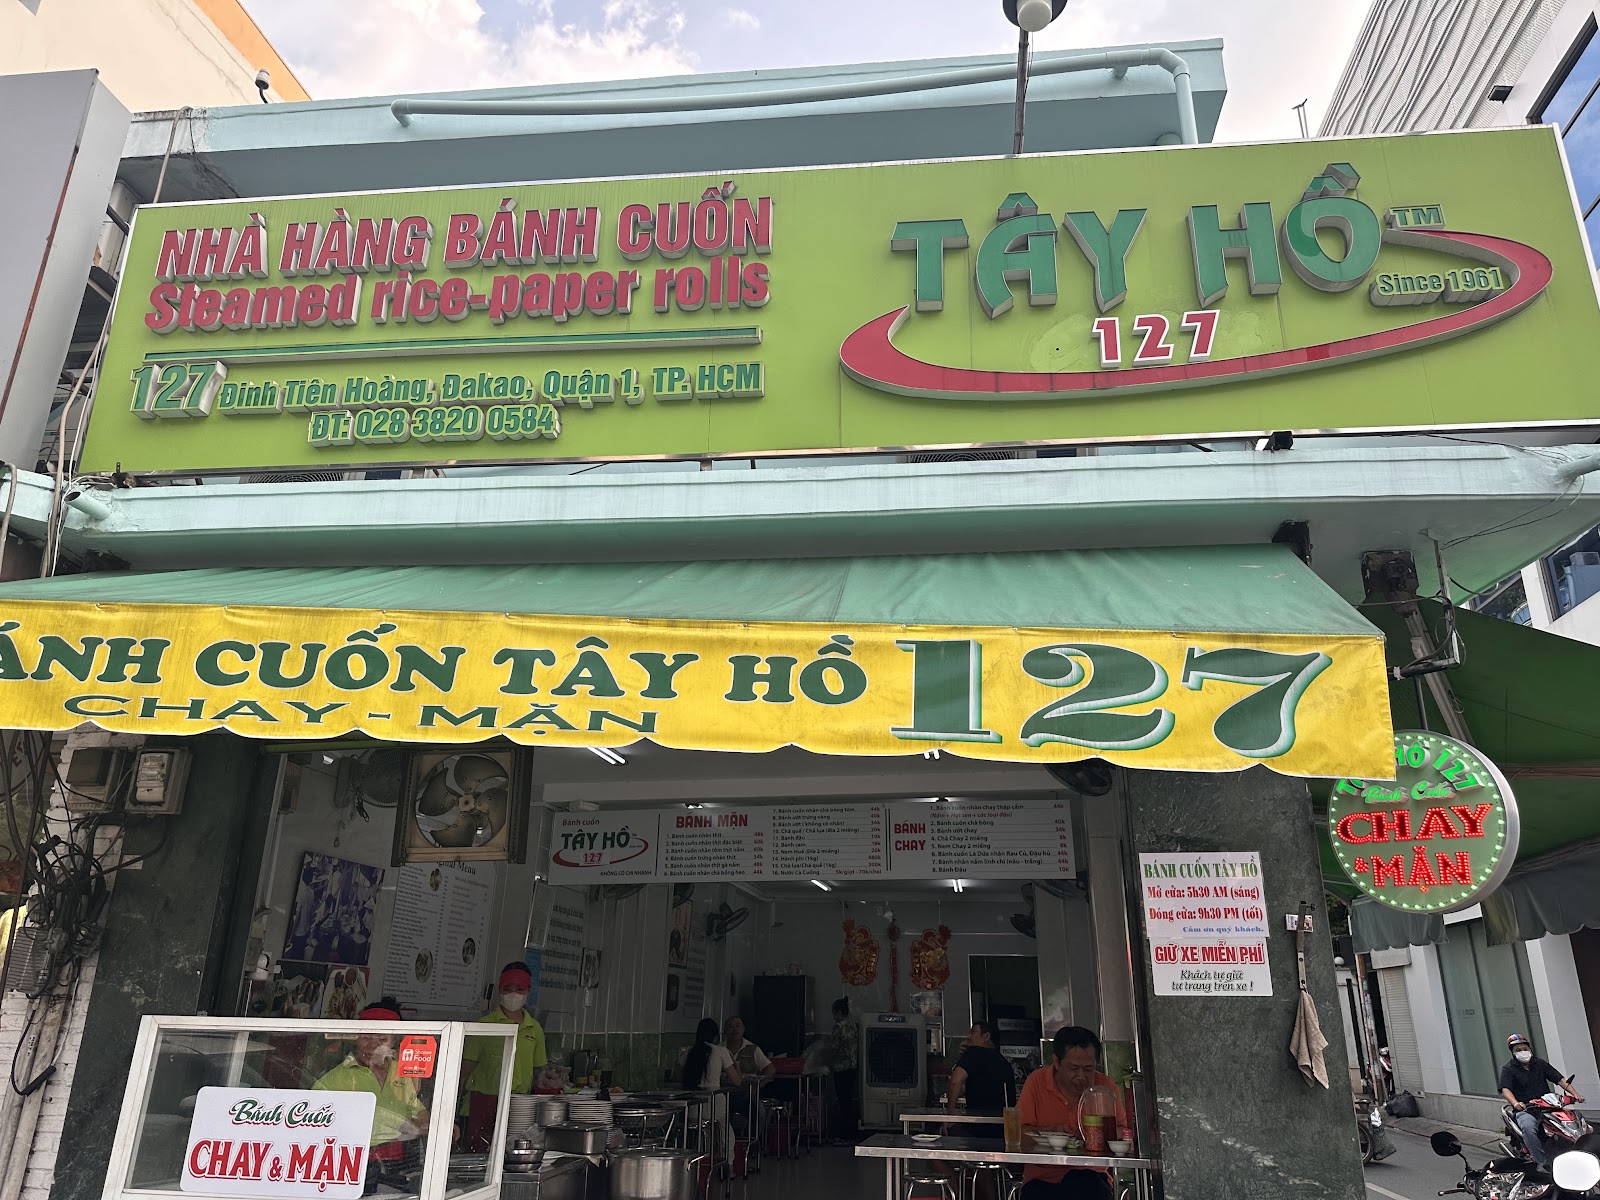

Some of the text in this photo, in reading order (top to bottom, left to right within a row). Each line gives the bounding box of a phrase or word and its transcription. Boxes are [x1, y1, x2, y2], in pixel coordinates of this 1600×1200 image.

[156, 181, 772, 280] NHÀ HÀNG BÁNH CUỐN
[891, 162, 1445, 319] TÂY HỒ TM
[144, 256, 770, 333] Steamed rice-paper rolls
[1374, 266, 1503, 304] Since 1961
[1091, 309, 1220, 368] 127
[131, 361, 224, 418] 127
[283, 379, 342, 412] Tiên
[342, 374, 438, 409] Hoàng,
[442, 372, 537, 404] Đakao,
[543, 368, 616, 408] Quận
[620, 367, 644, 404] 1,
[652, 366, 692, 400] TP.
[697, 361, 764, 399] HCM
[308, 402, 560, 446] ĐT: 028 3820 0584
[195, 623, 467, 693] CUỐN
[493, 635, 699, 699] TÂY
[724, 634, 868, 706] HỒ
[889, 638, 1333, 759] 127
[64, 695, 350, 723] CHAY
[417, 703, 657, 735] MẶN
[1432, 749, 1482, 791] 127
[562, 817, 600, 826] Bánh cuốn
[676, 811, 748, 829] BÁNH MẶN
[894, 819, 926, 834] BÁNH
[1336, 803, 1492, 844] CHAY
[561, 825, 630, 850] TÂY HỒ
[895, 840, 926, 851] CHAY
[584, 853, 602, 864] 127
[1143, 855, 1258, 878] BÁNH CUỐN TÂY HỒ
[1354, 845, 1473, 893] & MẶN
[1147, 884, 1260, 900] Mở cửa: 5h30 AM (sáng)
[1149, 905, 1263, 922] Đóng cửa: 9h30 PM (tối)
[1216, 926, 1231, 934] quý
[1234, 925, 1264, 933] khách.
[1155, 939, 1265, 964] GIỮ XE MIỄN PHÍ
[1180, 969, 1212, 981] Khách
[1184, 982, 1212, 993] trang
[1214, 980, 1235, 991] trên
[1236, 983, 1247, 991] xe
[229, 1097, 336, 1128] Bánh Cuốn
[188, 1136, 364, 1191] CHAY & MẶN
